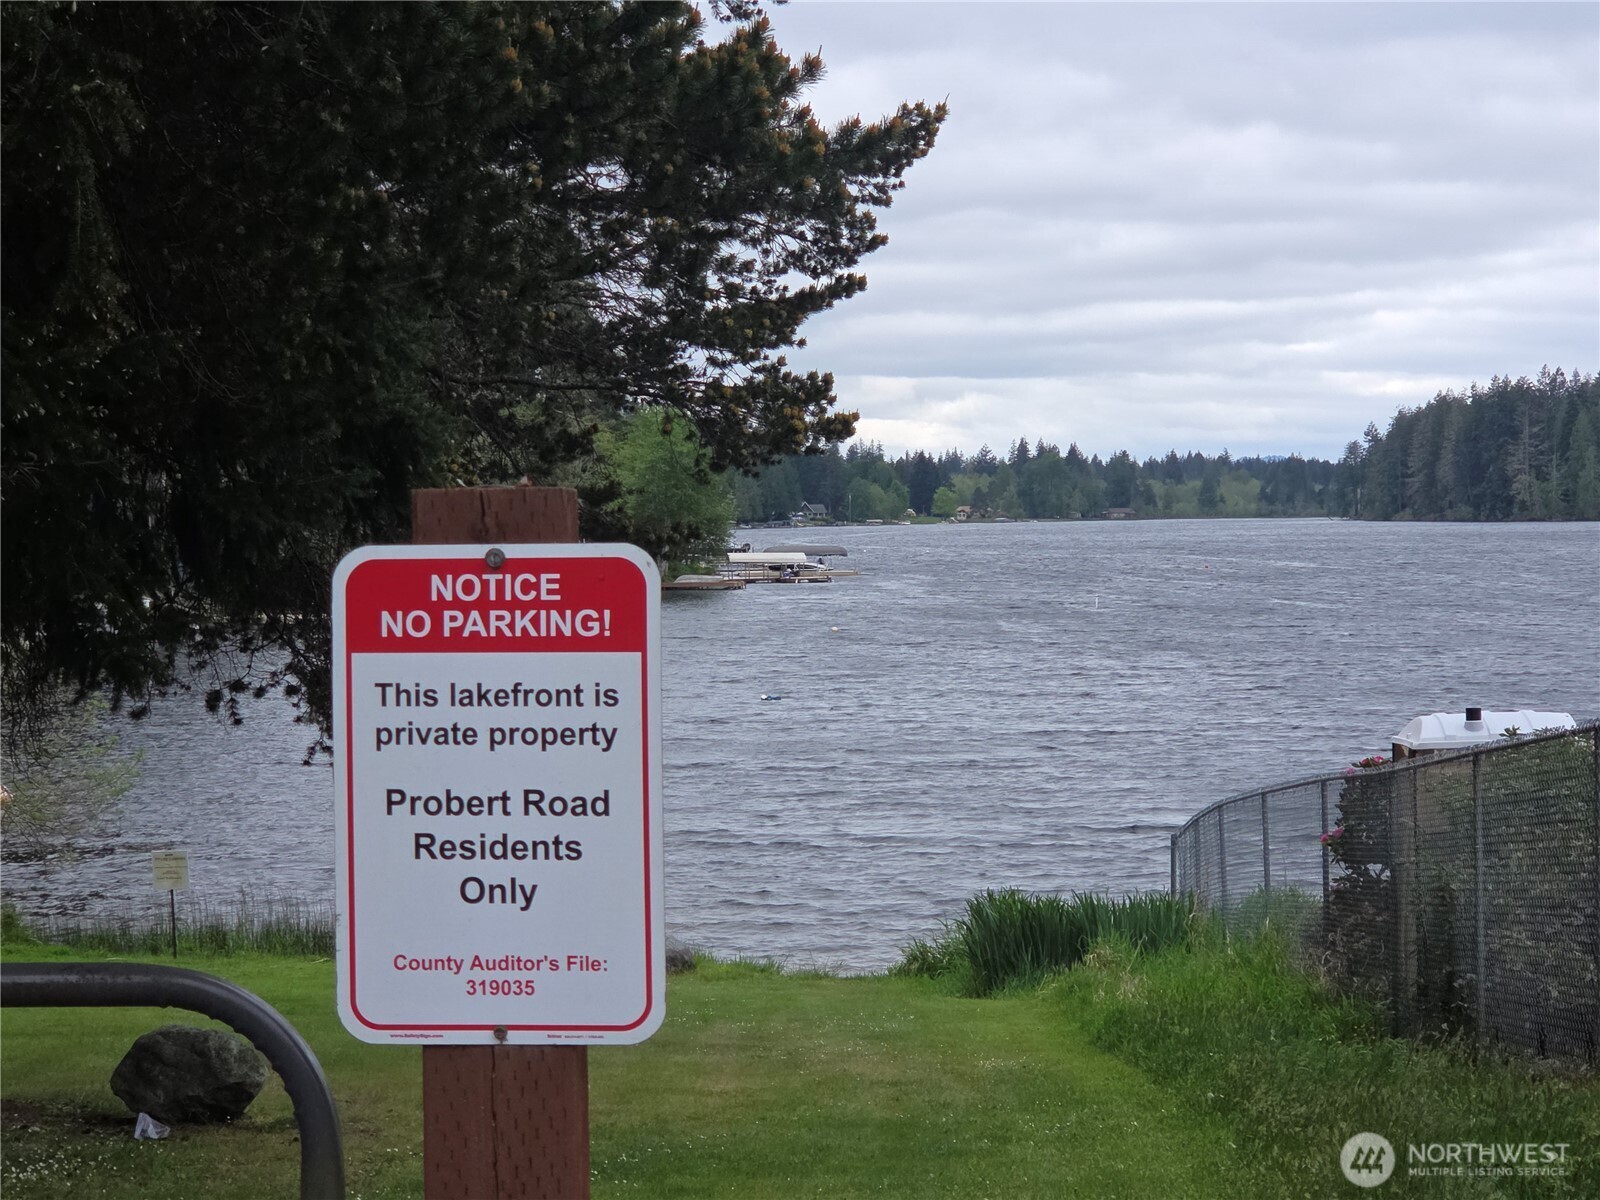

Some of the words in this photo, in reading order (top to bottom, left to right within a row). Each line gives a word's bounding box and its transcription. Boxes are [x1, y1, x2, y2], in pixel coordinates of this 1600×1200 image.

[431, 573, 561, 601] NOTICE
[381, 610, 431, 638] NO
[443, 609, 611, 637] PARKING!
[374, 682, 438, 707] This
[450, 682, 584, 707] lakefront
[594, 682, 619, 707] is
[376, 721, 478, 751] private
[489, 722, 618, 752] property
[386, 788, 511, 817] Probert
[523, 789, 610, 817] Road
[414, 833, 583, 861] Residents
[459, 876, 538, 912] Only
[393, 954, 464, 975] County
[469, 955, 560, 971] Auditor's
[566, 955, 608, 972] File:
[466, 979, 535, 996] 319035
